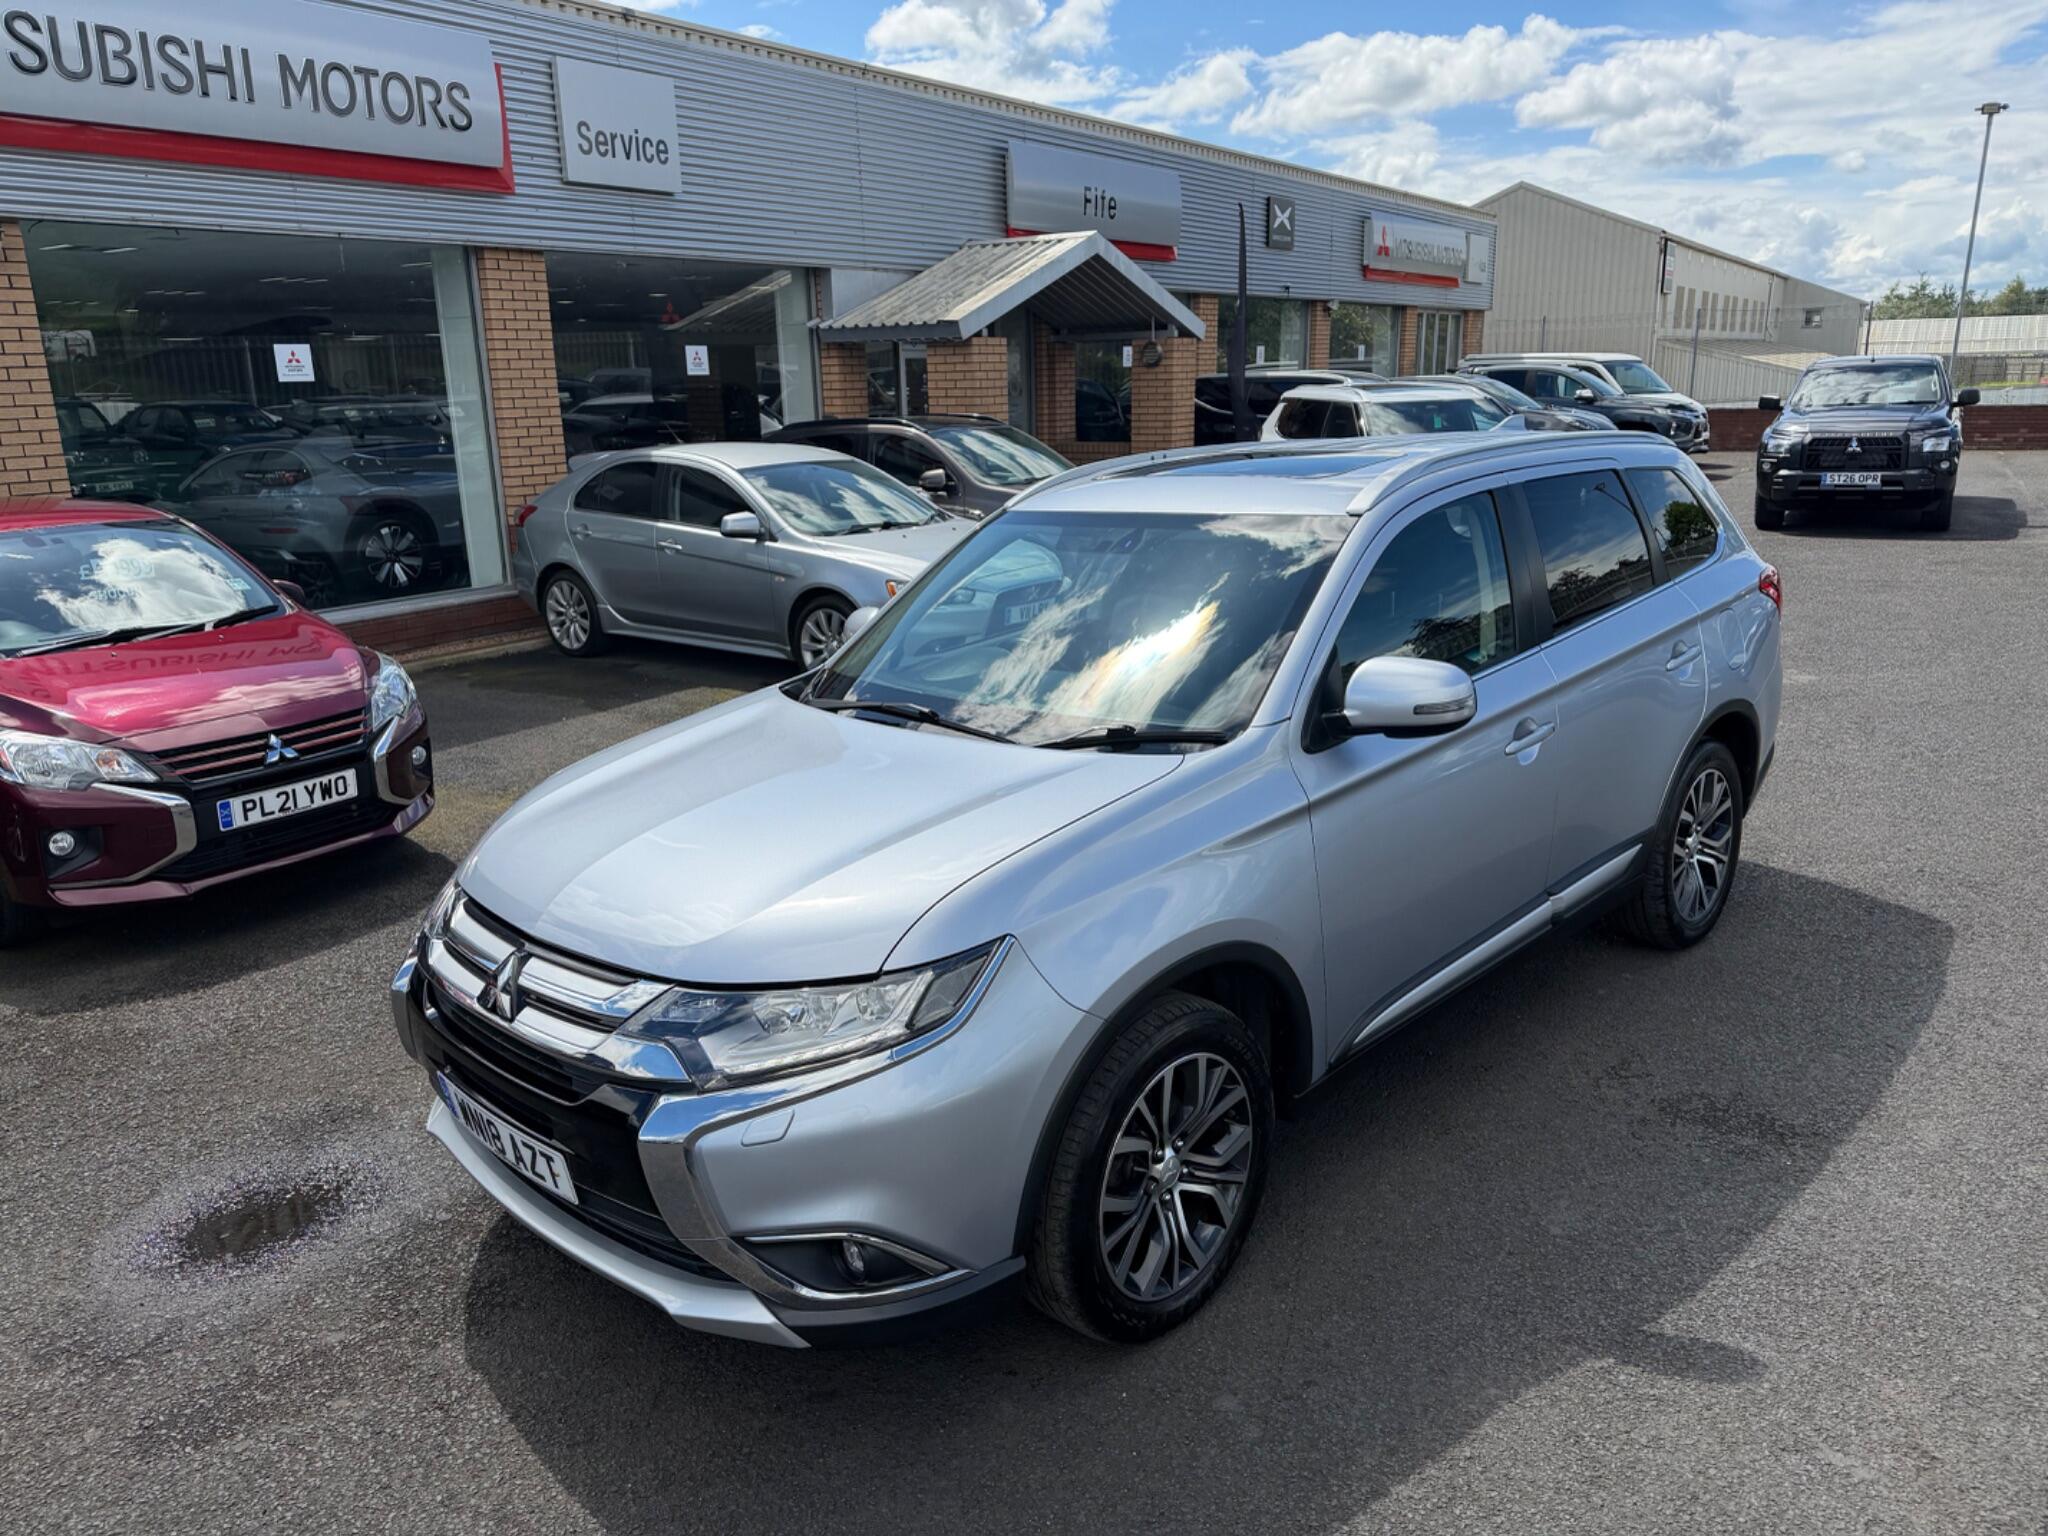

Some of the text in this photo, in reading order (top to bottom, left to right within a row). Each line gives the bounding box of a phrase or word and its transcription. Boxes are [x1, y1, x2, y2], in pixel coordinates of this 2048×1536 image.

[3, 9, 473, 133] SUBISHI MOTORS
[576, 120, 670, 166] Service
[1083, 185, 1117, 220] Fife
[1829, 473, 1880, 483] ST26 OPR
[241, 775, 348, 822] PL21 YWO
[509, 1132, 560, 1190] AZT
